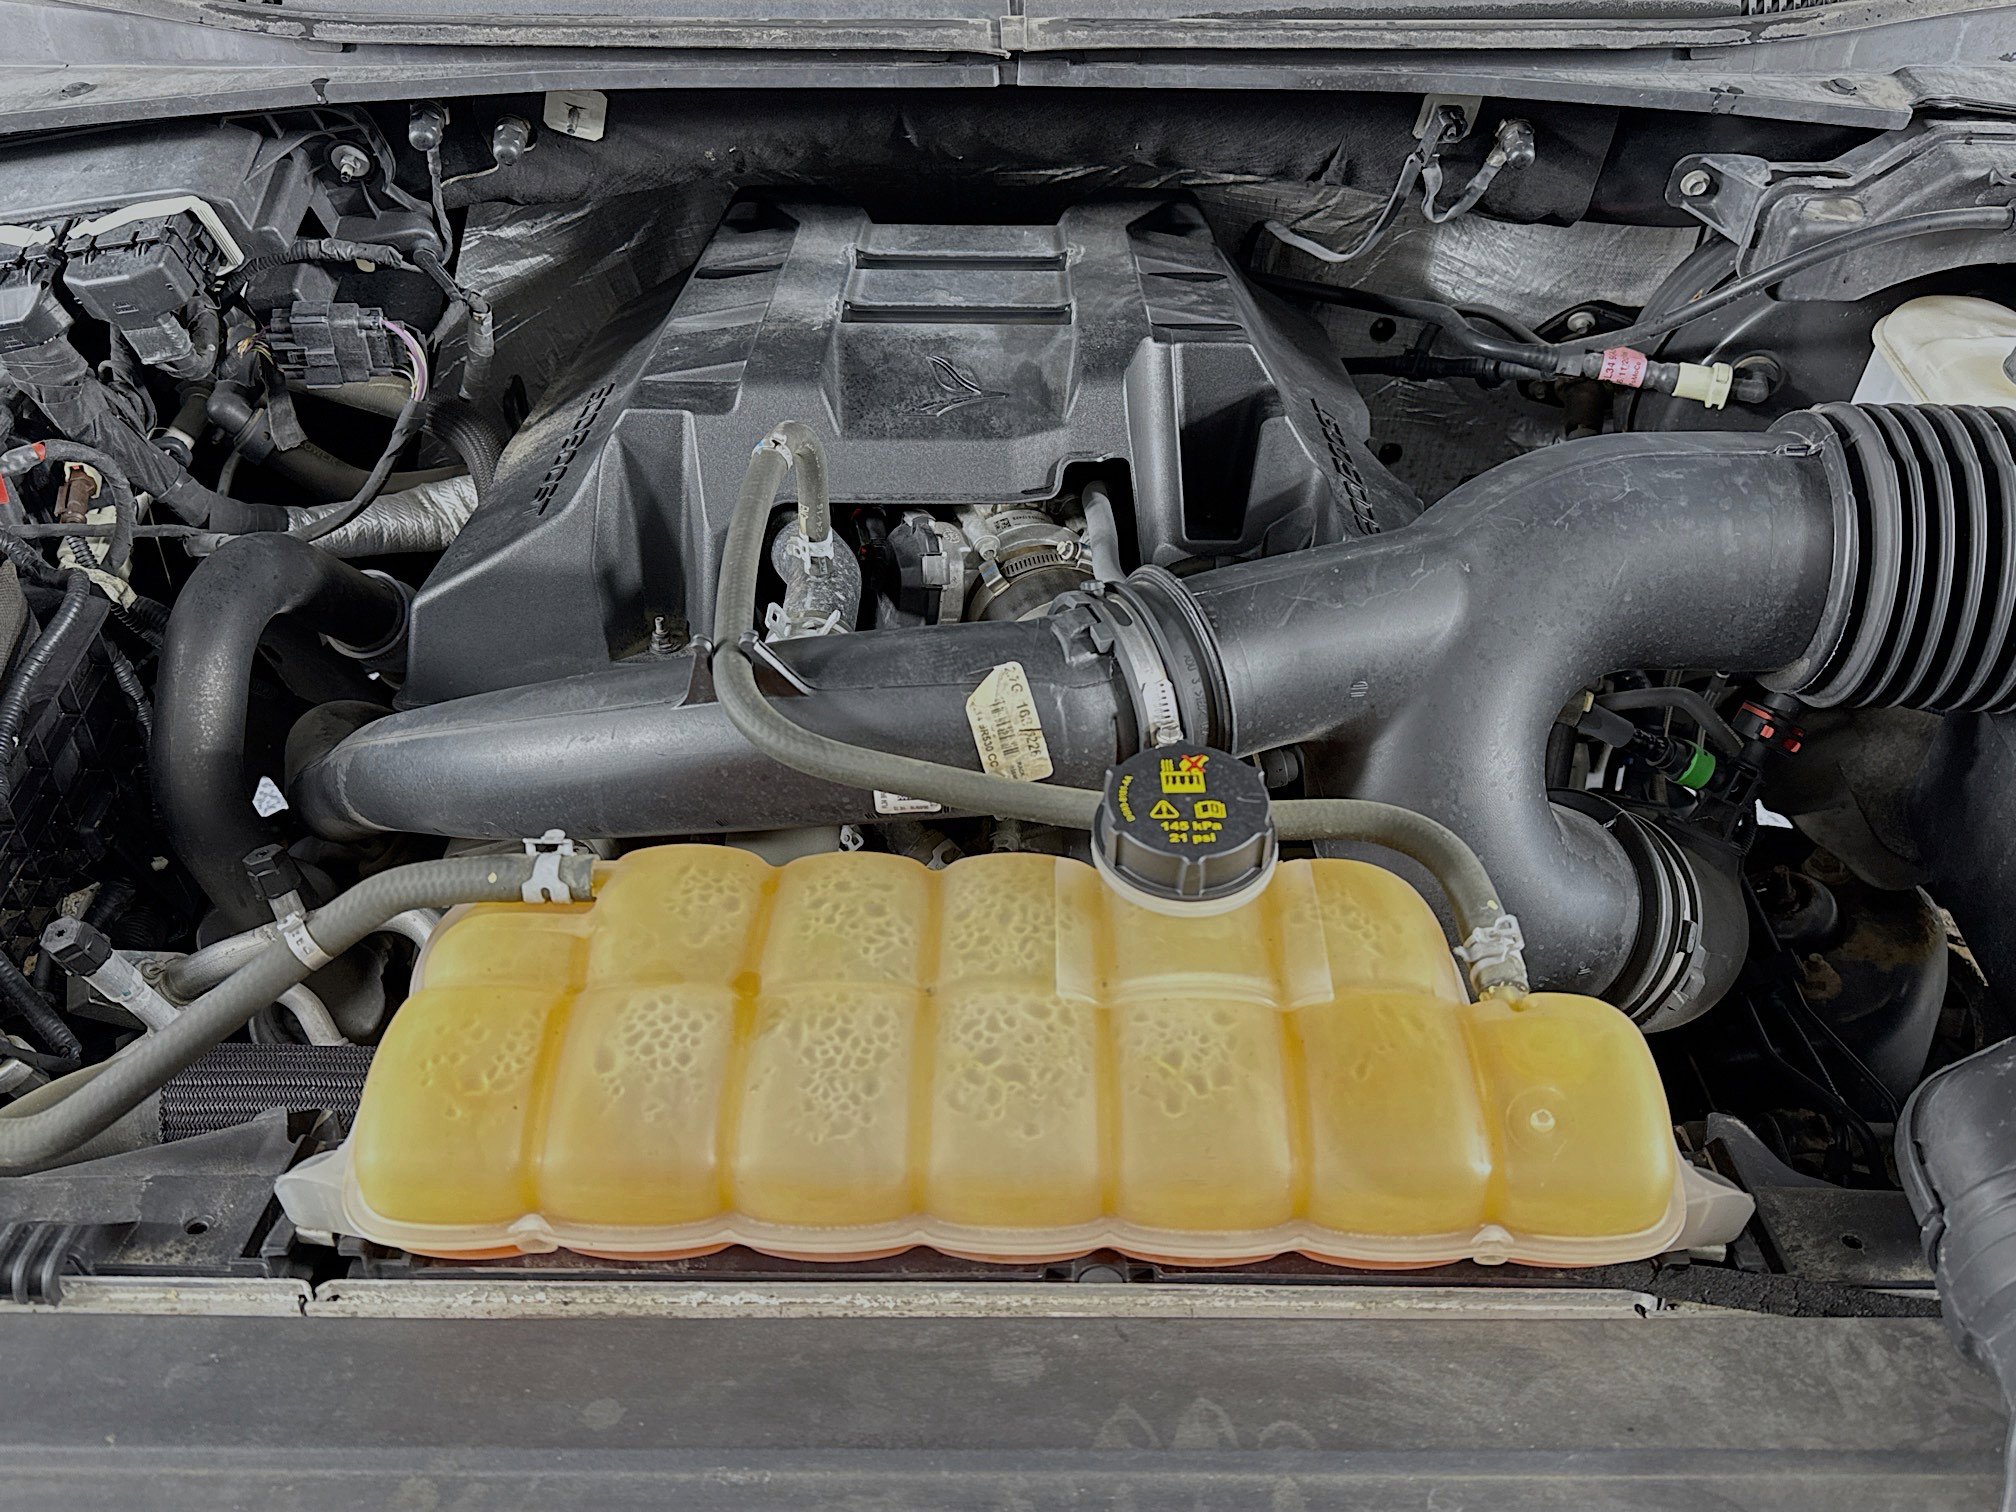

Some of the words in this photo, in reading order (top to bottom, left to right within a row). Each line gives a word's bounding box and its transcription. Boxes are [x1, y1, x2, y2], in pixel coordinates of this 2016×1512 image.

[987, 754, 999, 768] CC
[1160, 820, 1190, 831] 145
[1192, 820, 1223, 831] kPa
[1168, 832, 1189, 844] 21
[1192, 833, 1216, 845] psi
